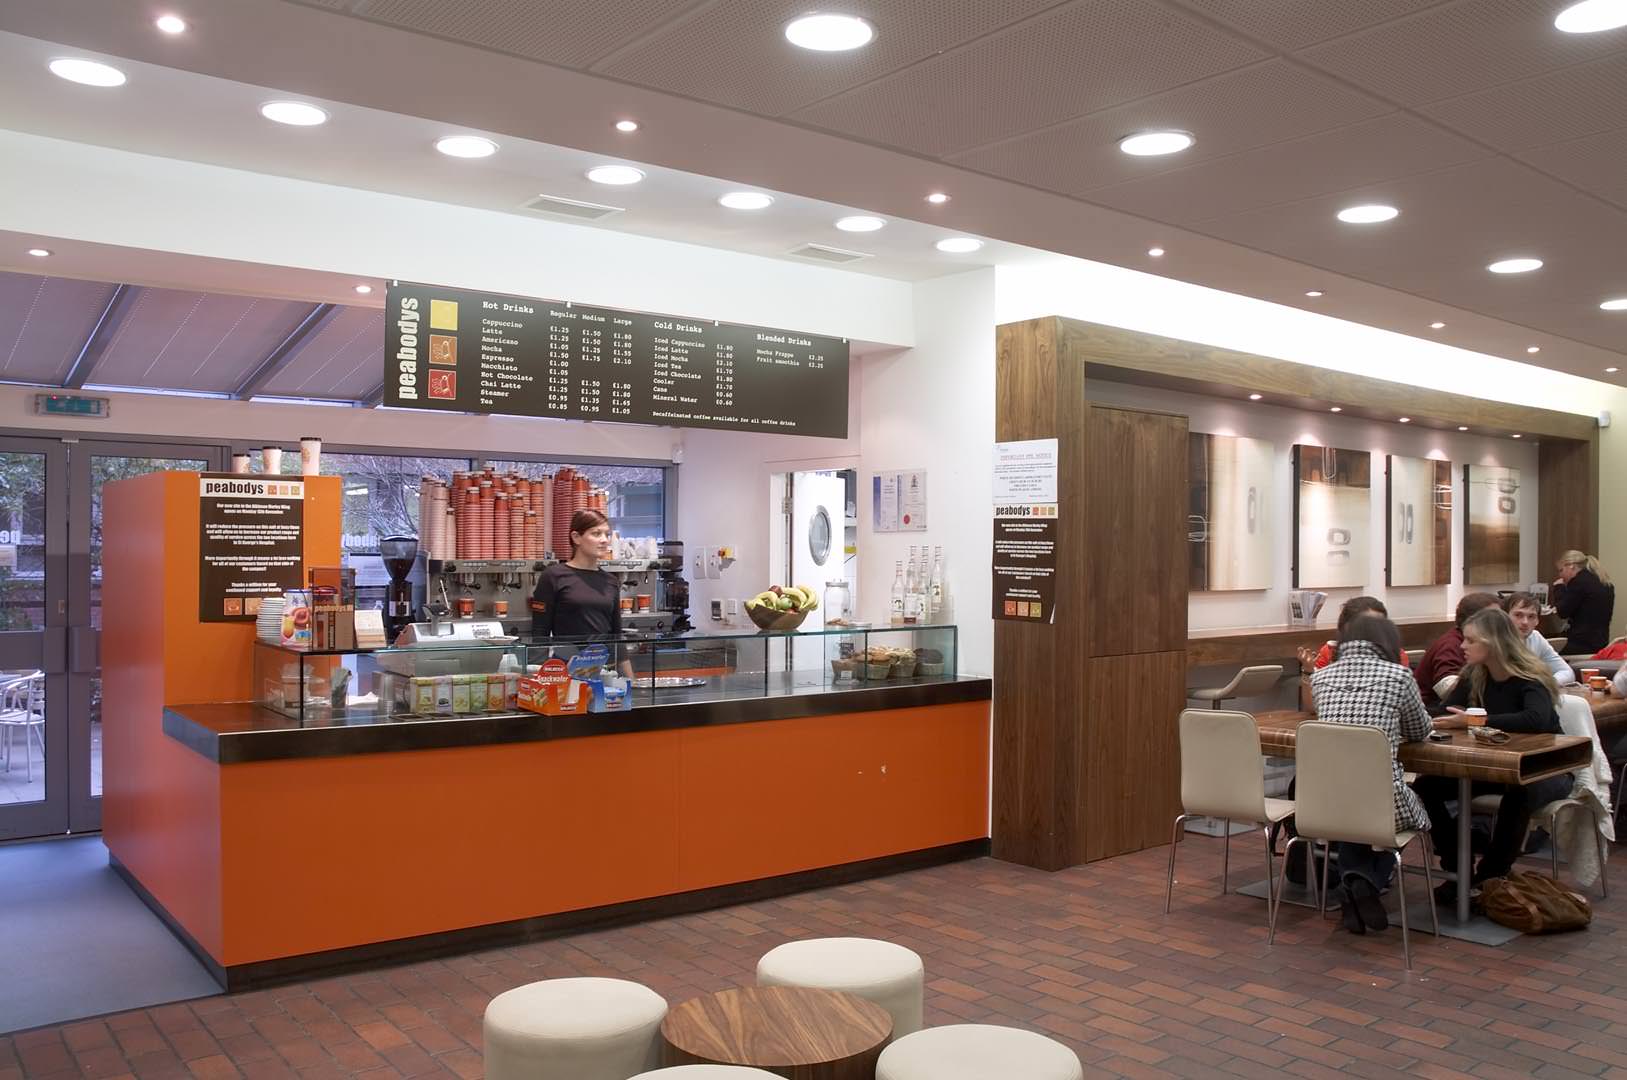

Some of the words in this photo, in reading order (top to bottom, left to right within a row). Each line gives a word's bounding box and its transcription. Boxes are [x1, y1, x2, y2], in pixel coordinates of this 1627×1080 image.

[483, 302, 498, 310] Hot
[504, 304, 534, 314] Drinks
[482, 319, 523, 328] Cappuccino
[654, 322, 672, 330] Cold
[676, 324, 702, 333] Drinks
[482, 337, 518, 345] Americano
[757, 334, 785, 343] Blended
[788, 338, 812, 346] Drinks
[397, 298, 419, 399] peabodys
[482, 354, 514, 362] Espresso
[497, 373, 533, 381] Chocolate
[206, 482, 264, 494] peabodys
[996, 505, 1030, 516] peabodys
